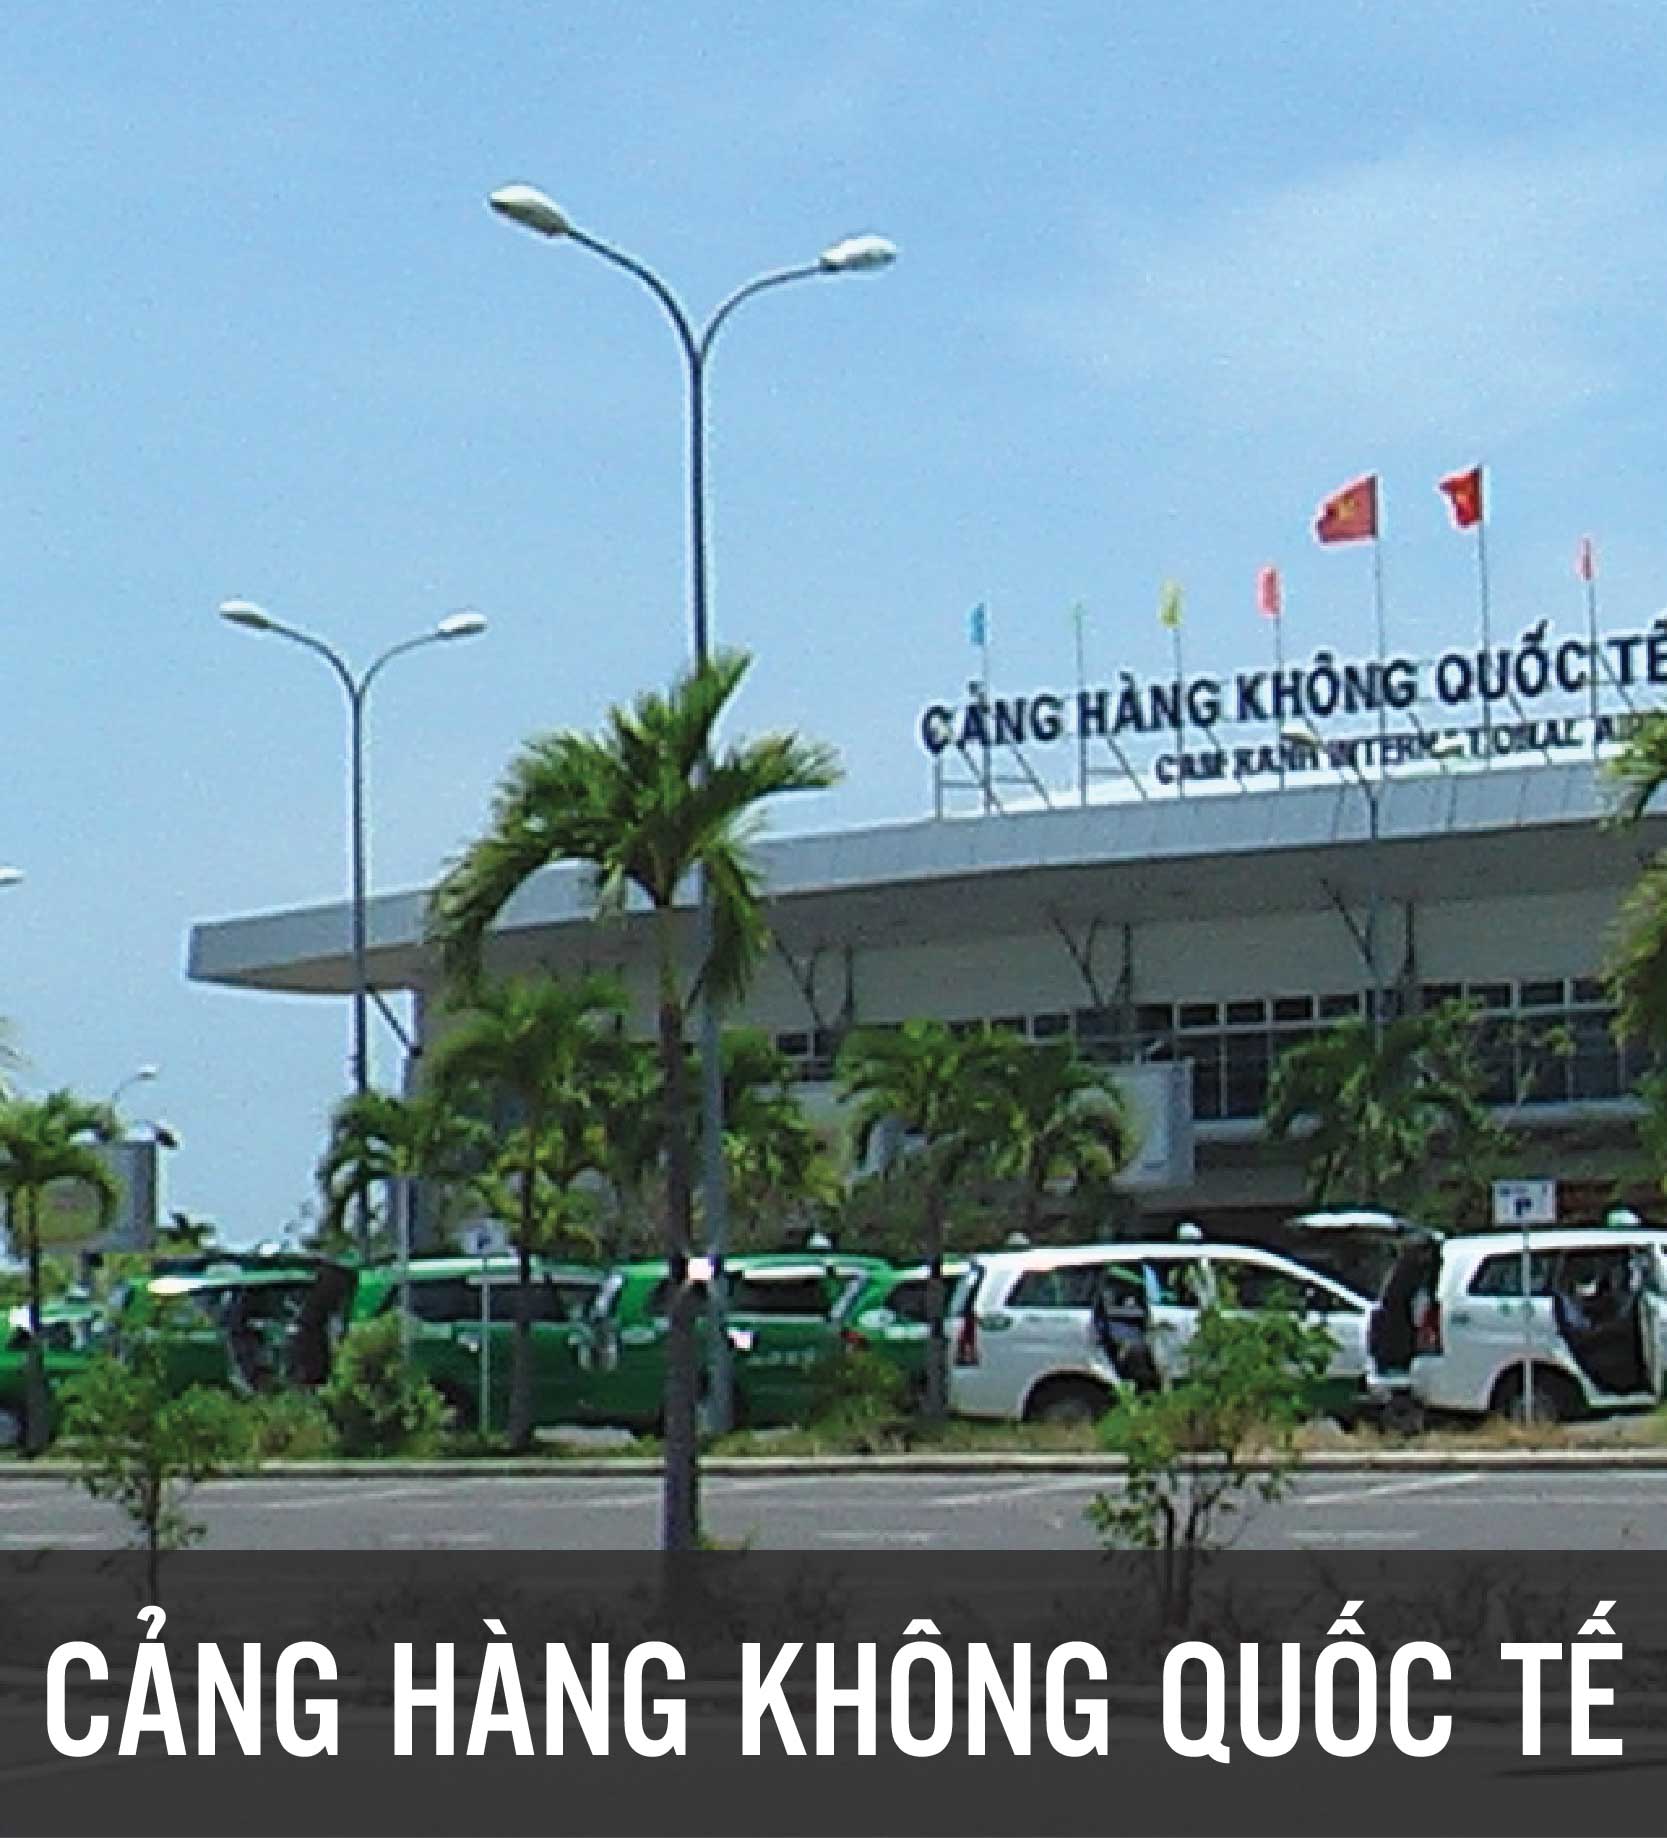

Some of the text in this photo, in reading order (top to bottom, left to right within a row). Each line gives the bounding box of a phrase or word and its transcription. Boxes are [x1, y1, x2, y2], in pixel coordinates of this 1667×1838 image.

[921, 681, 1063, 754] CẢNG
[1078, 672, 1220, 738] HÀNG
[1236, 650, 1418, 721] KHÔNG
[1436, 620, 1590, 706] QUỐC
